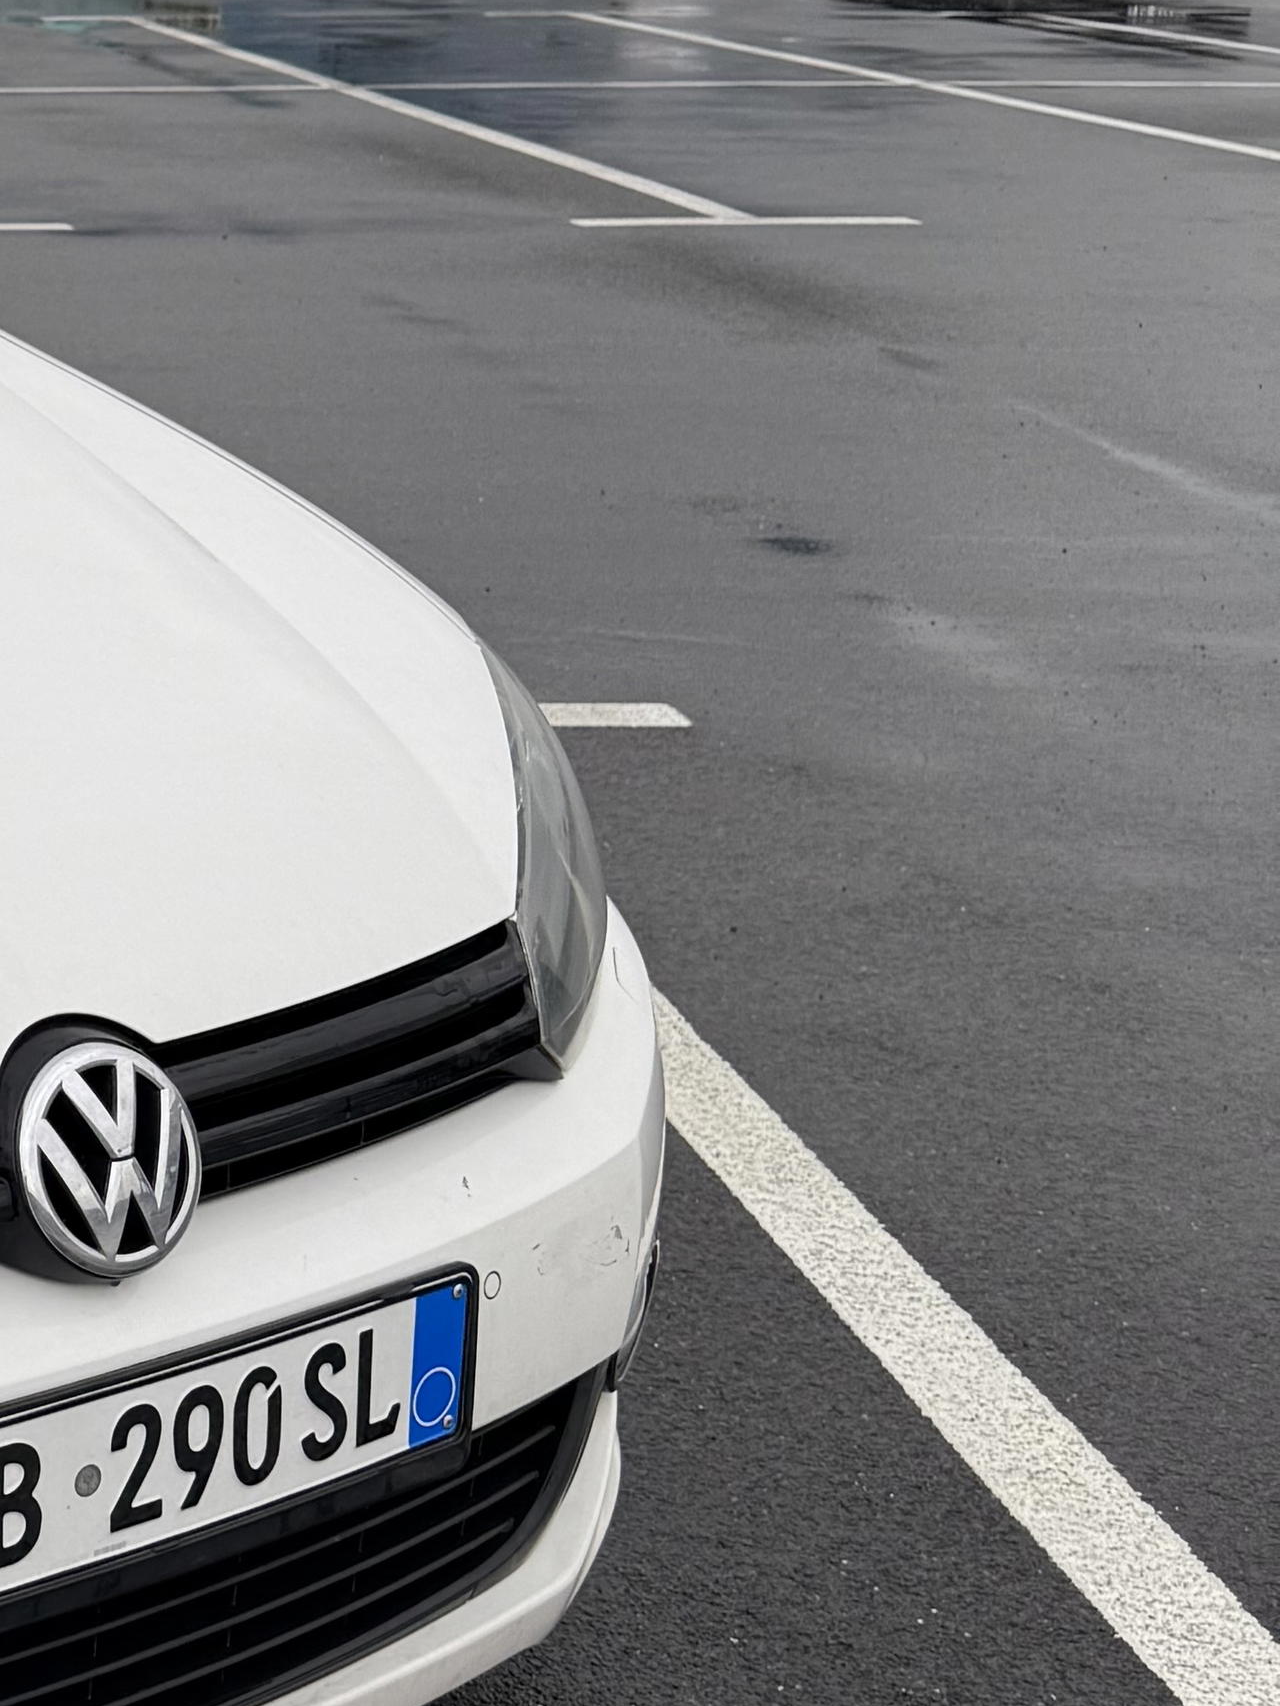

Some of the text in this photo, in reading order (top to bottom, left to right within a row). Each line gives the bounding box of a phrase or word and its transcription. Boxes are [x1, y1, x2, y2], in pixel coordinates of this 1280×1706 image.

[24, 1047, 198, 1273] VW
[110, 1366, 282, 1534] 290
[301, 1328, 401, 1462] SL
